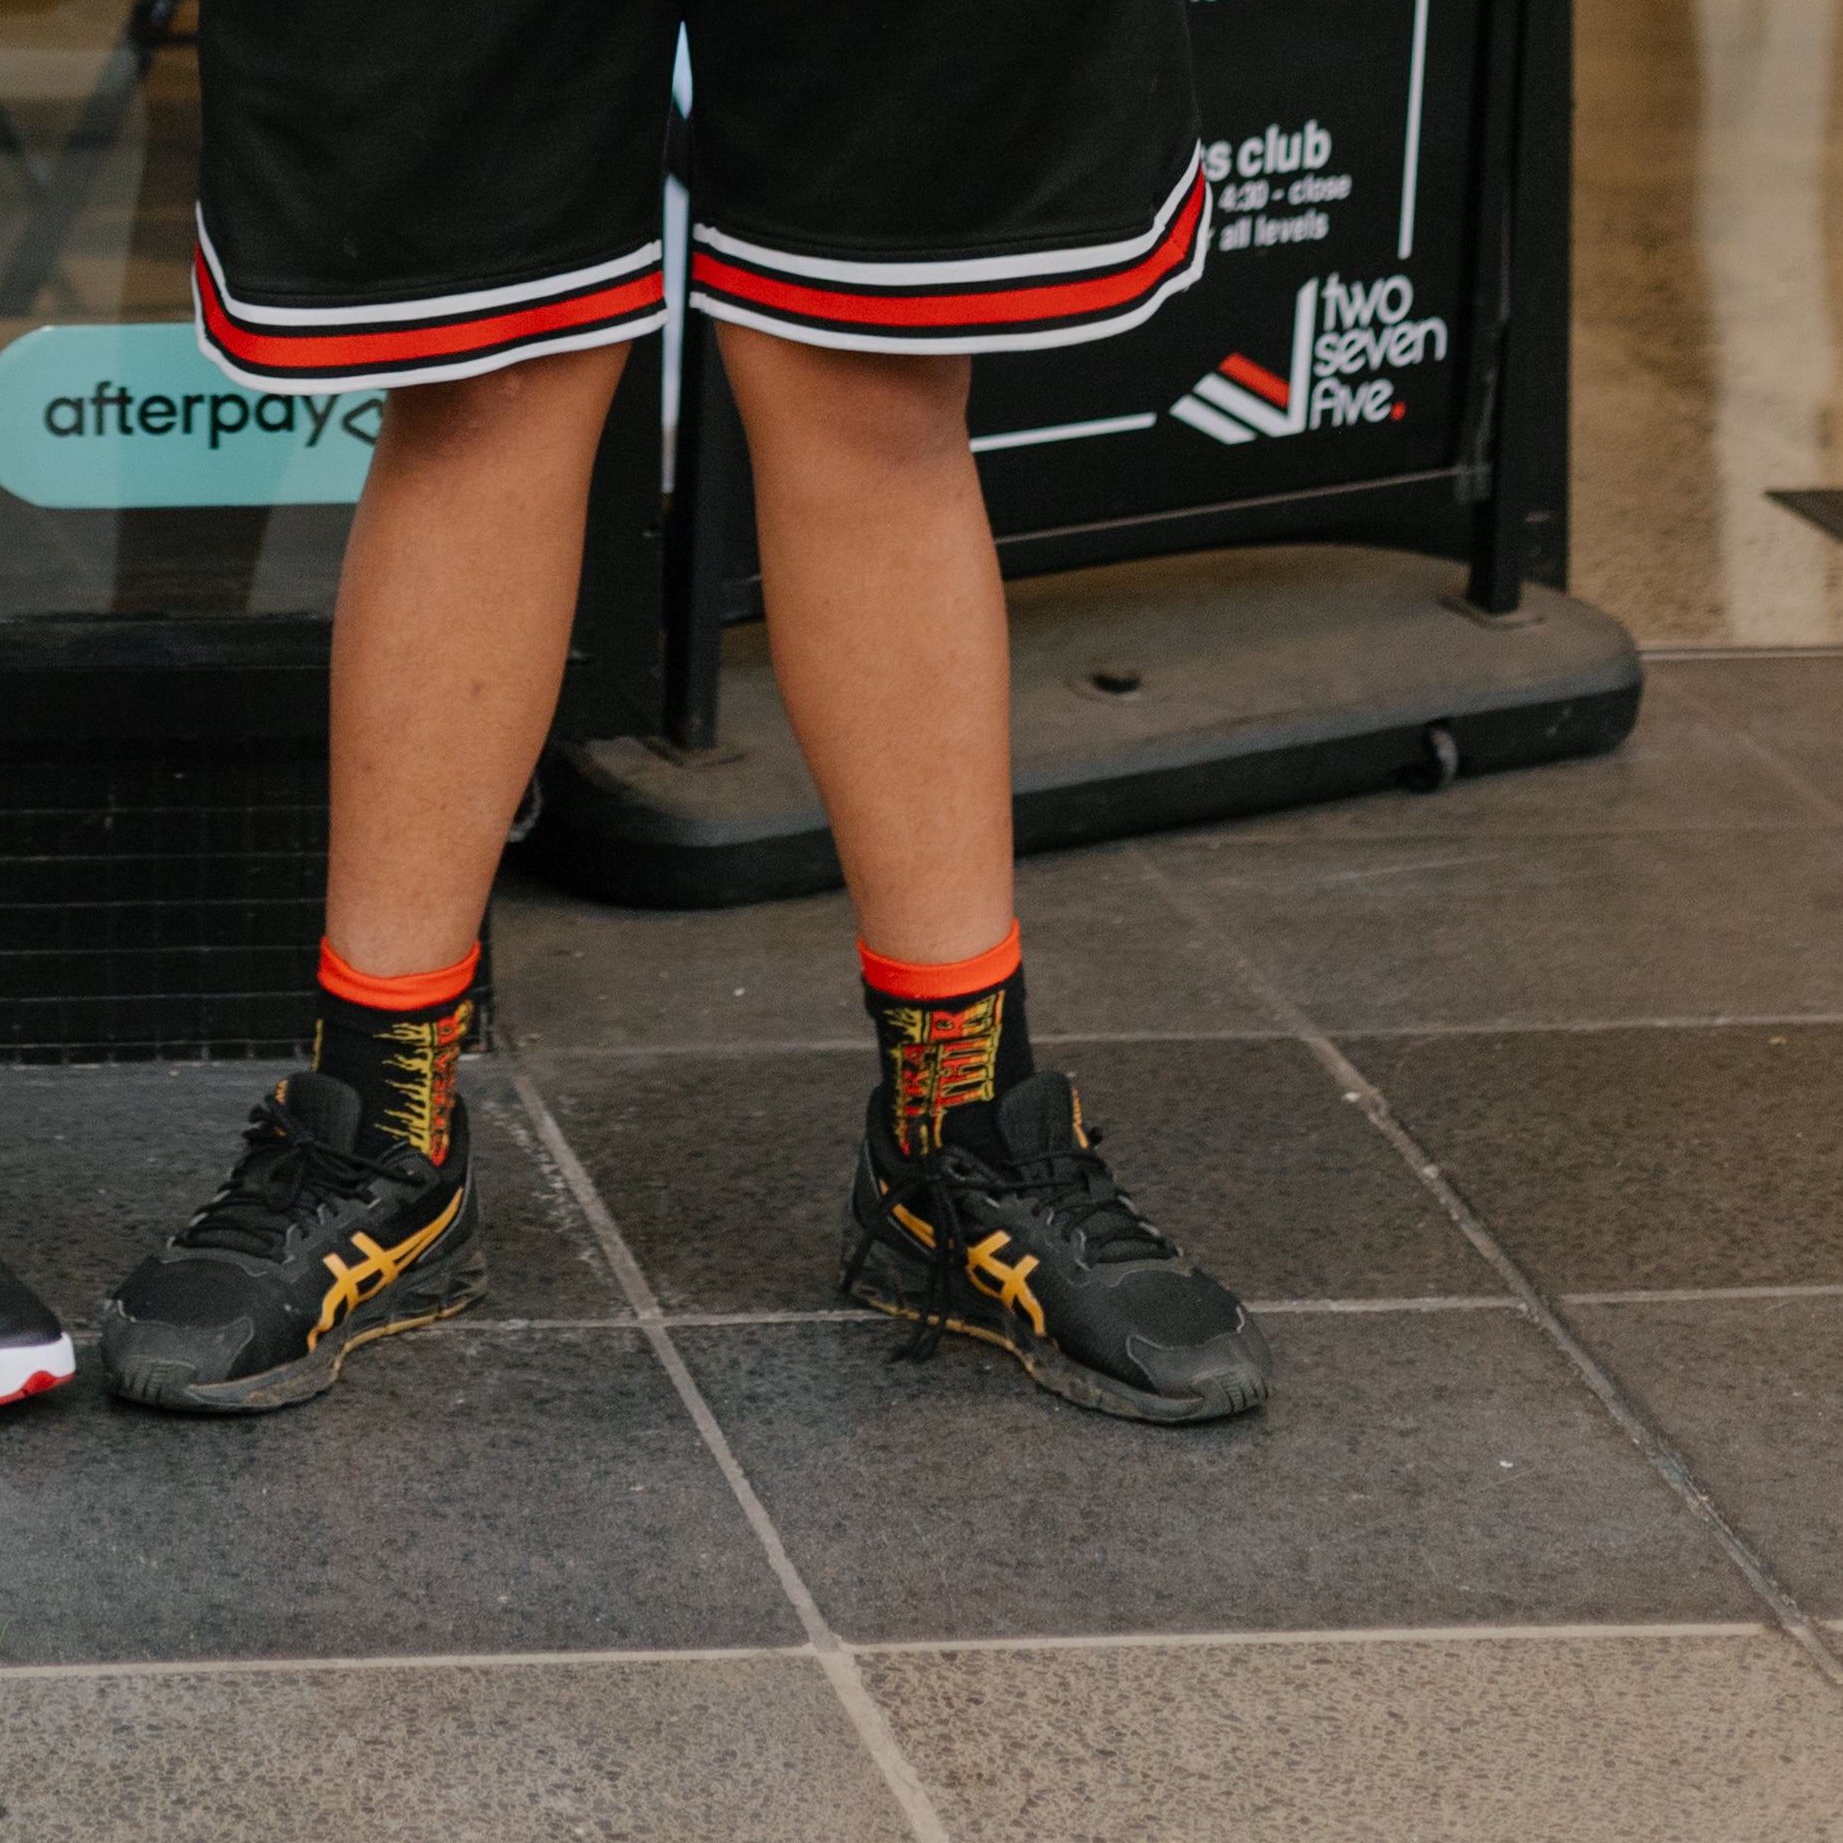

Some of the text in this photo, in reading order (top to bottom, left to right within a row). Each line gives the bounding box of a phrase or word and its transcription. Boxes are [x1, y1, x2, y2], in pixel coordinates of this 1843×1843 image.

[1236, 118, 1332, 179] club
[1219, 216, 1252, 252] all
[1321, 271, 1414, 332] two
[1314, 316, 1449, 378] seven
[44, 380, 340, 449] afterpay
